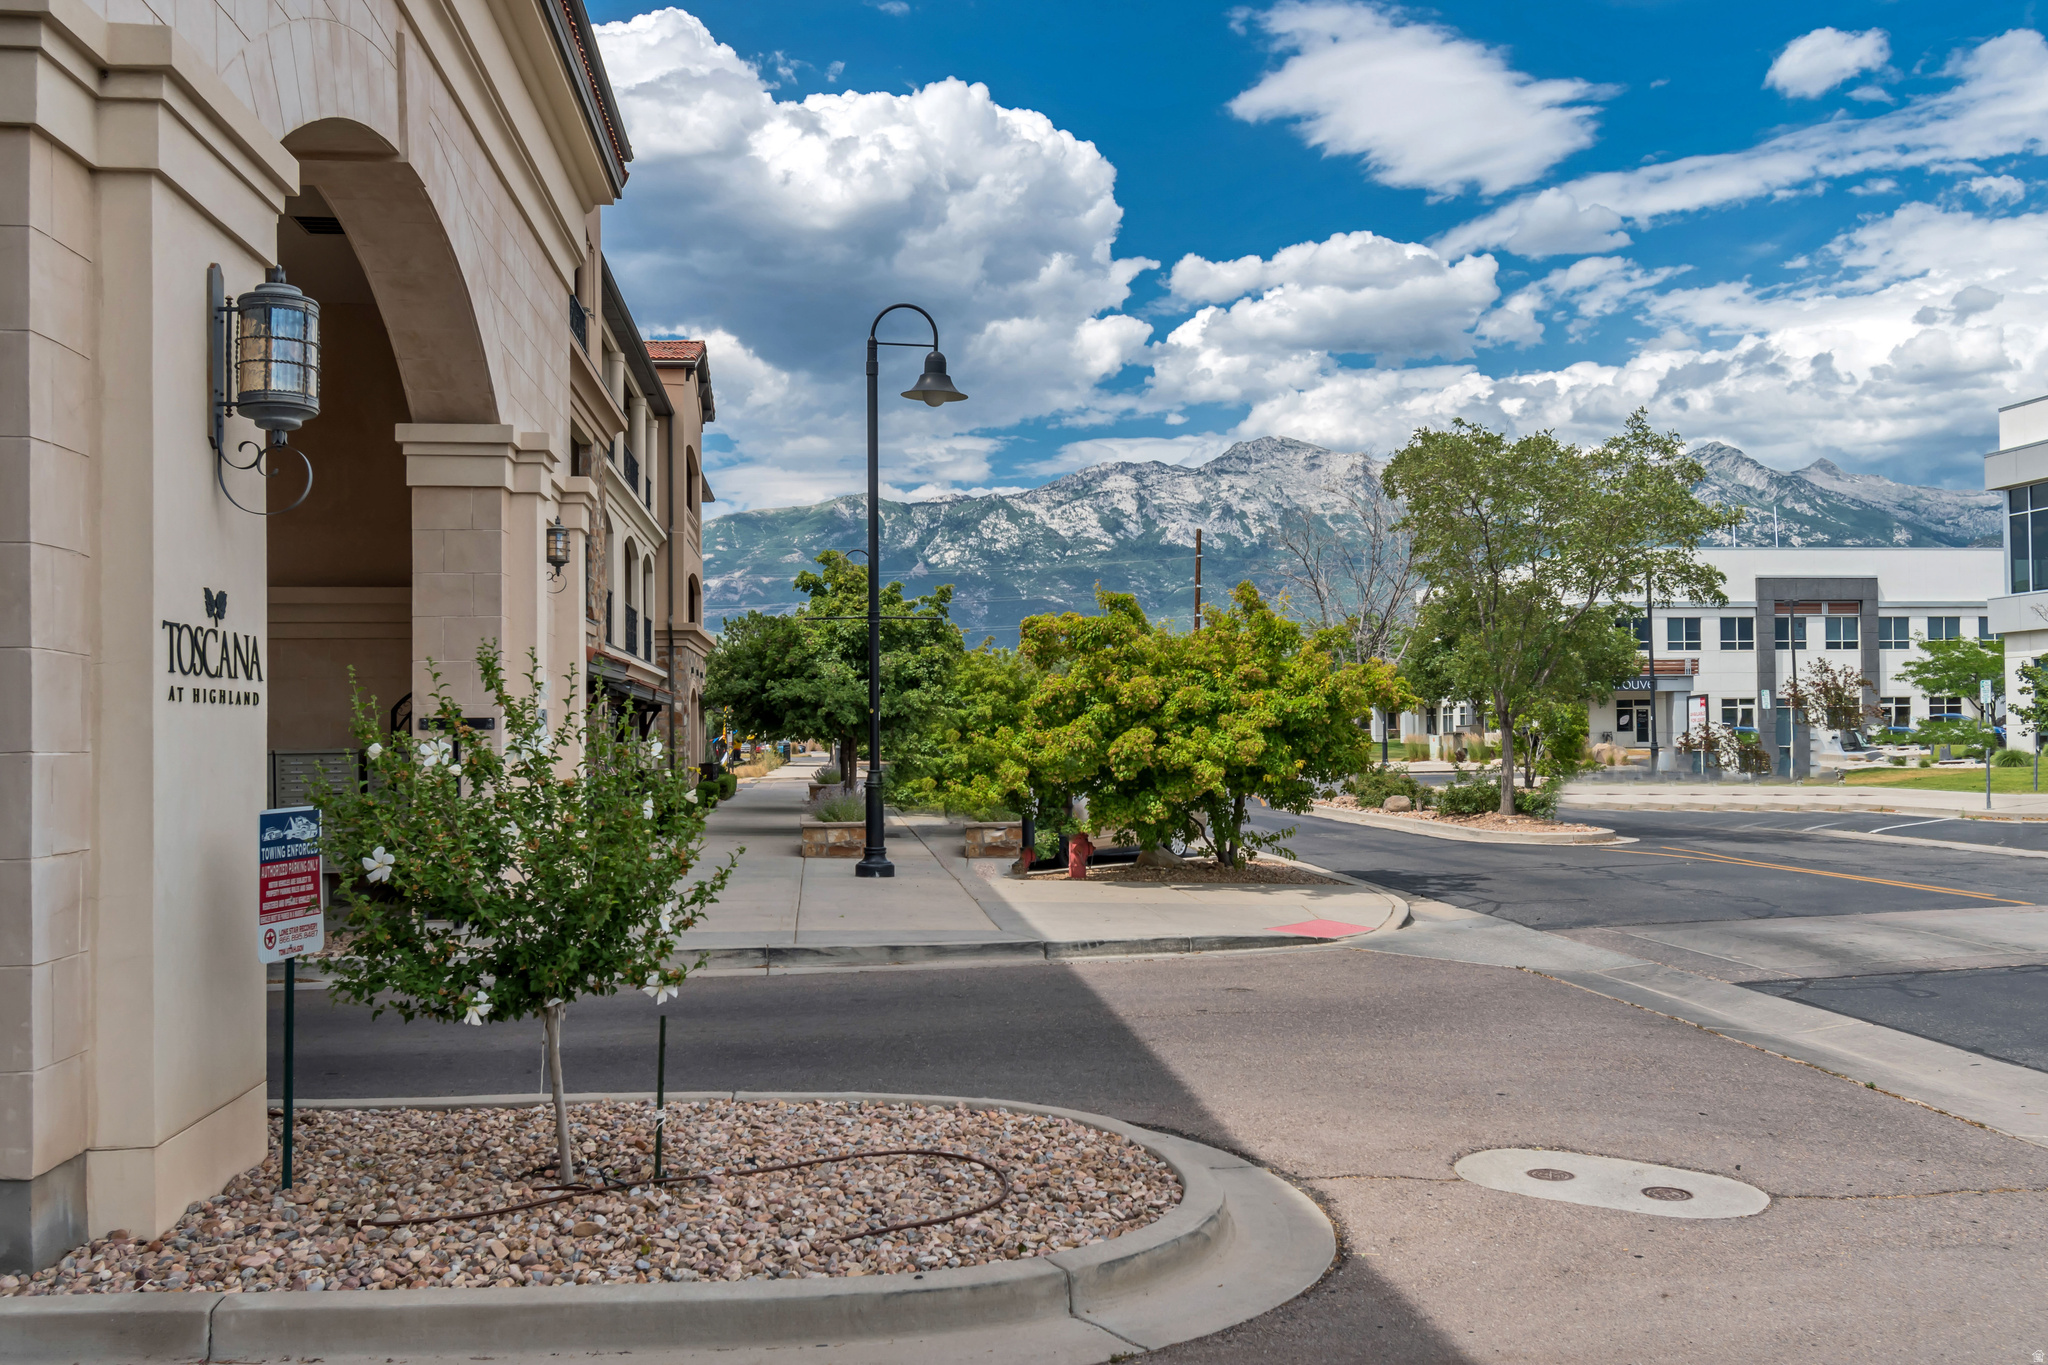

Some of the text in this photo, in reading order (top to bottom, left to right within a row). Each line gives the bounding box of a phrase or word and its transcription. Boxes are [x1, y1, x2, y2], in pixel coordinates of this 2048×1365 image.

[162, 620, 263, 681] TOSCANA
[168, 686, 259, 705] AT HIGHLAND
[261, 842, 318, 861] TOWING ENFORCED
[288, 861, 307, 874] PARKING
[308, 859, 319, 871] ONLY
